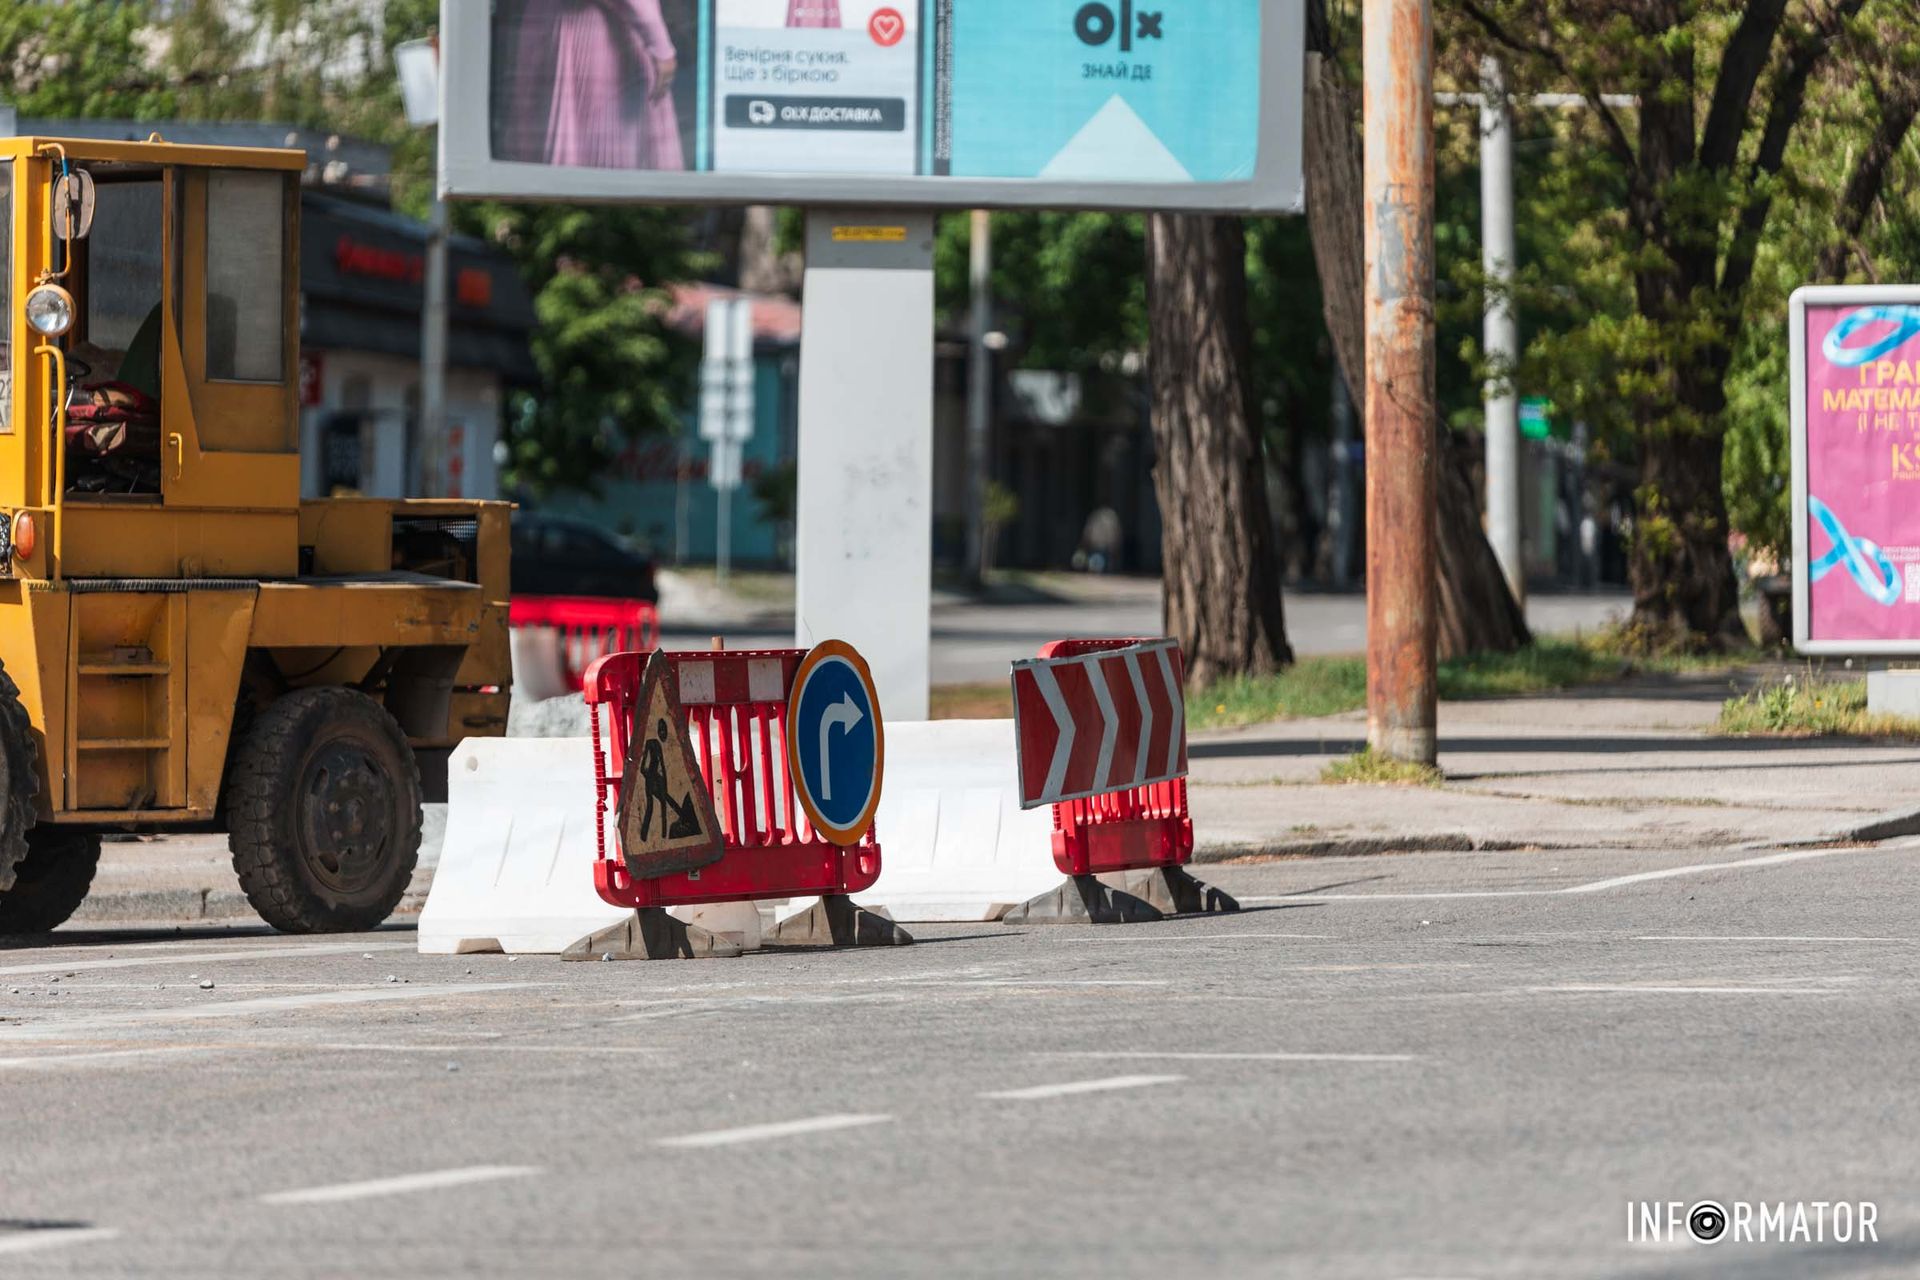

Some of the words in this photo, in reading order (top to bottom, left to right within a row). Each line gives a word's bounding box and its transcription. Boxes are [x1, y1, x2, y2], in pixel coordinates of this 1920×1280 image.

[1073, 0, 1163, 51] olx
[725, 46, 793, 63] Вечірня
[724, 63, 756, 82] Ще
[771, 64, 839, 84] біркою
[1082, 61, 1127, 78] ЗНАЙ
[1131, 64, 1151, 80] ДЕ
[809, 106, 883, 122] ДОСТАВКА
[1860, 359, 1920, 386] ГРА
[1874, 412, 1899, 431] НЕ
